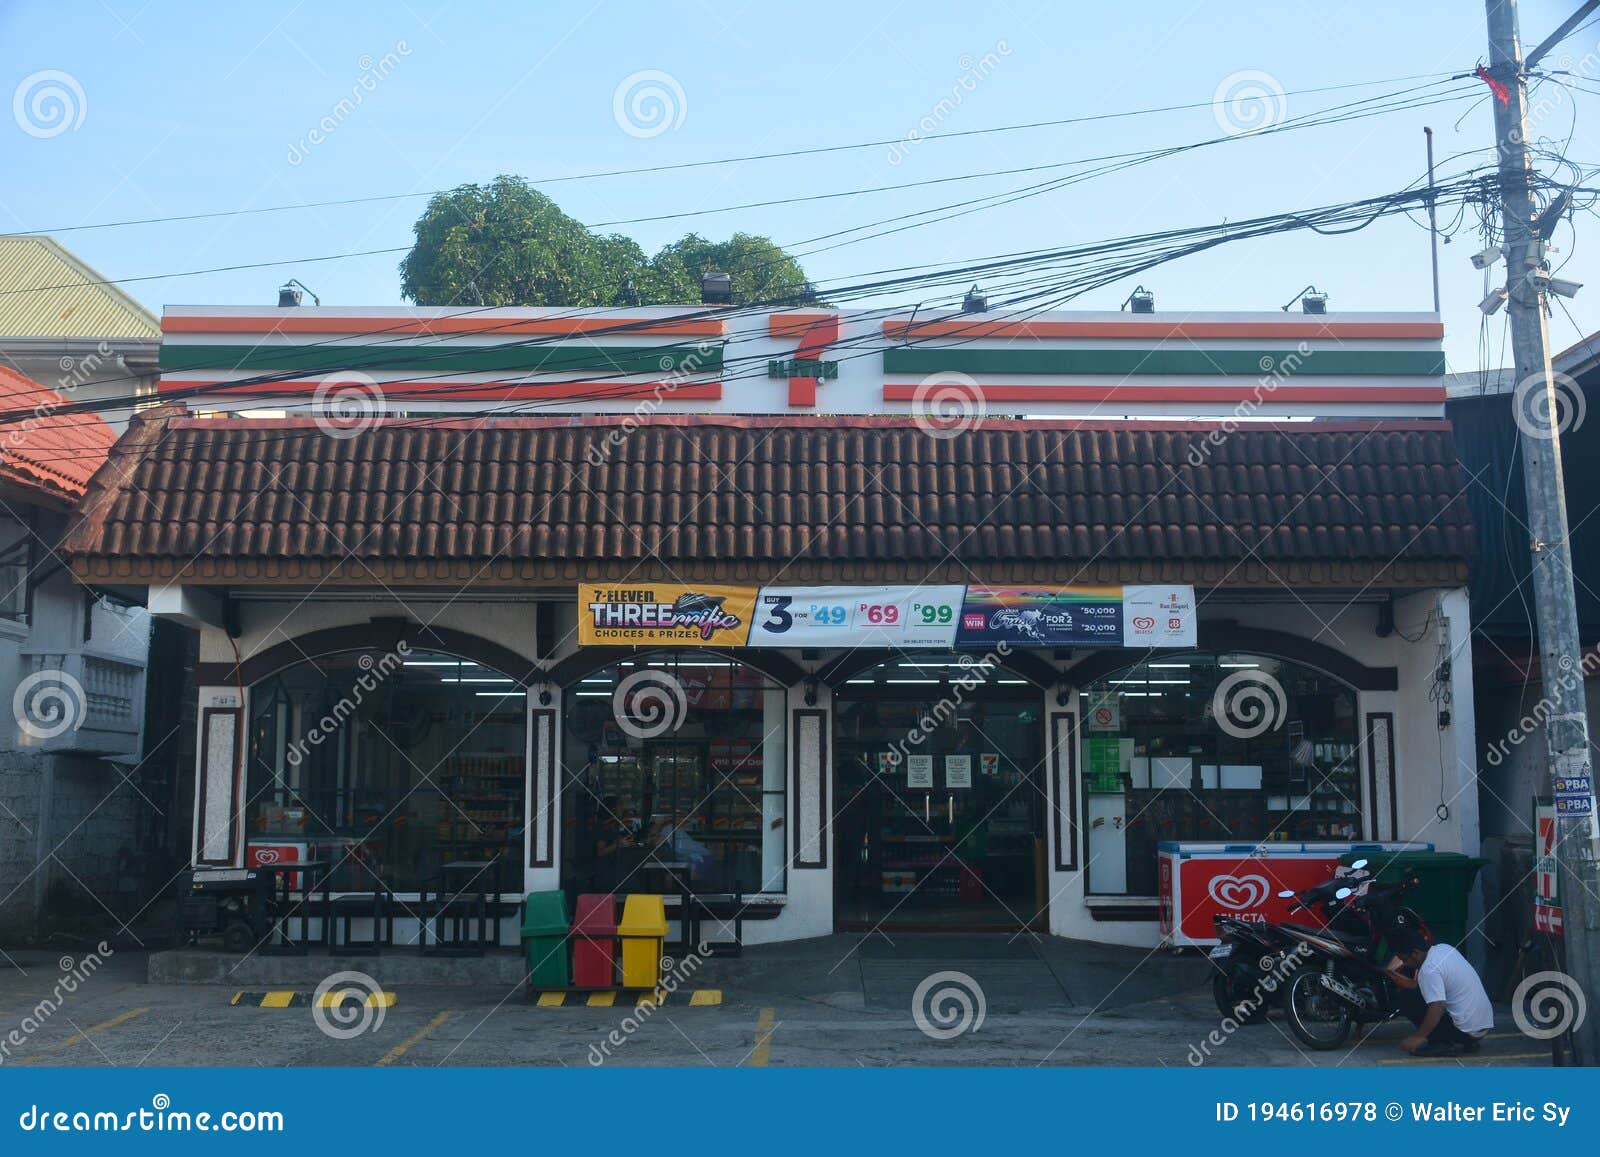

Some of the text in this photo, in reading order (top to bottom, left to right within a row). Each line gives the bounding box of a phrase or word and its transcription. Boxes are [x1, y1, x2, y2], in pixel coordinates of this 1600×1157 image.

[769, 314, 839, 407] 7
[762, 596, 793, 634] 3
[1046, 615, 1073, 624] FOR 2
[965, 620, 984, 628] WIN
[595, 630, 699, 638] CHOICES & PRIZES
[1565, 779, 1589, 790] PBA
[1566, 799, 1590, 810] PBA
[1215, 913, 1267, 923] ECTA
